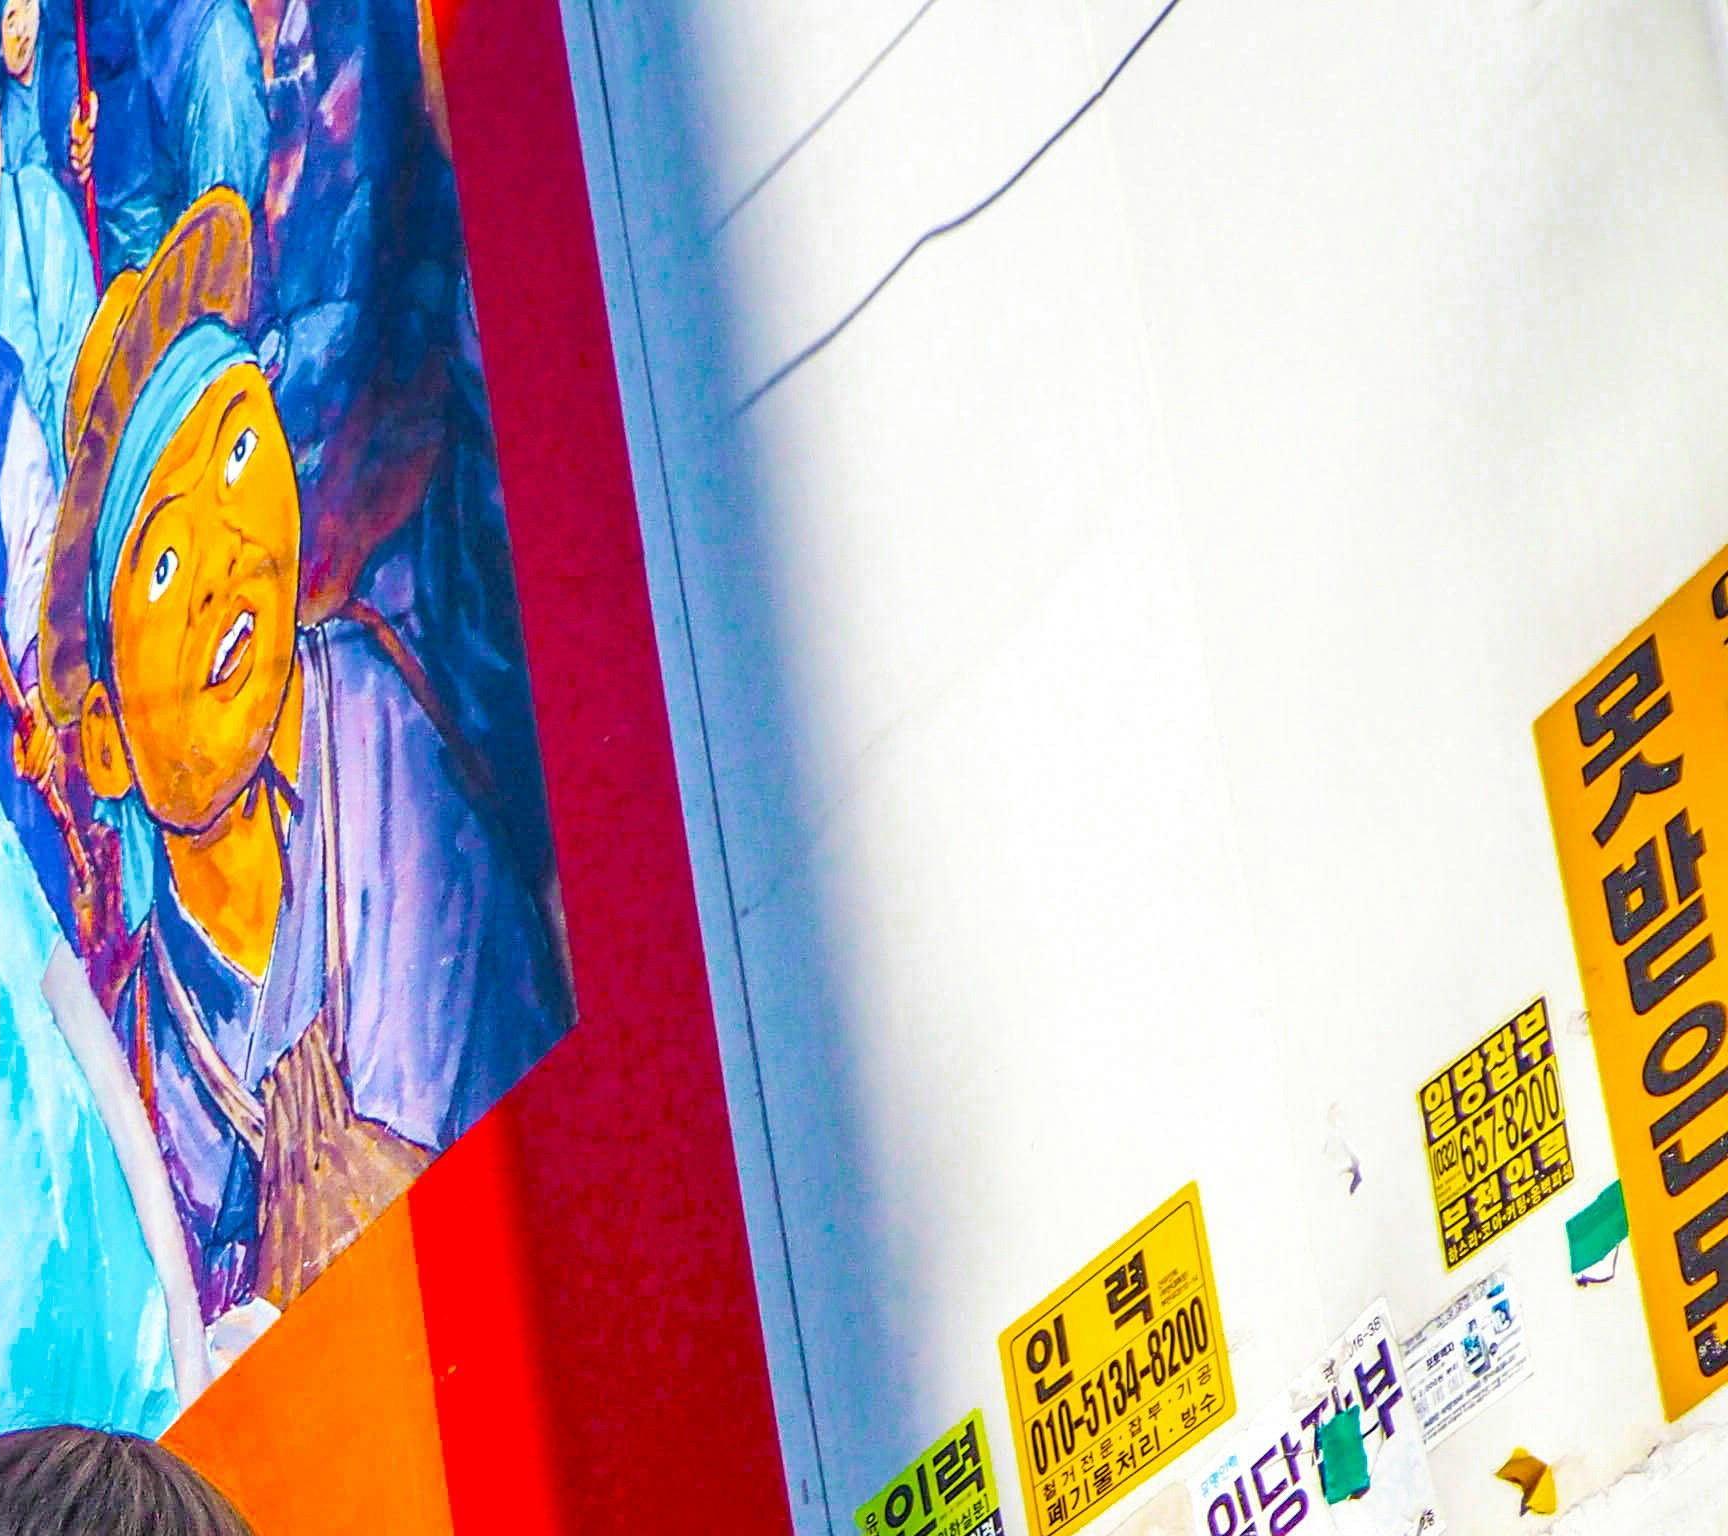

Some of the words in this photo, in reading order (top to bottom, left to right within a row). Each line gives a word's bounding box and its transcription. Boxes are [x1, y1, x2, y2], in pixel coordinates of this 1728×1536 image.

[1423, 1000, 1552, 1139] 일당잡부
[1432, 1134, 1458, 1178] (032)
[1458, 1062, 1562, 1183] 657-8200
[1031, 1296, 1209, 1475] 010-5134-8200
[1047, 1425, 1161, 1527] 폐기물처리
